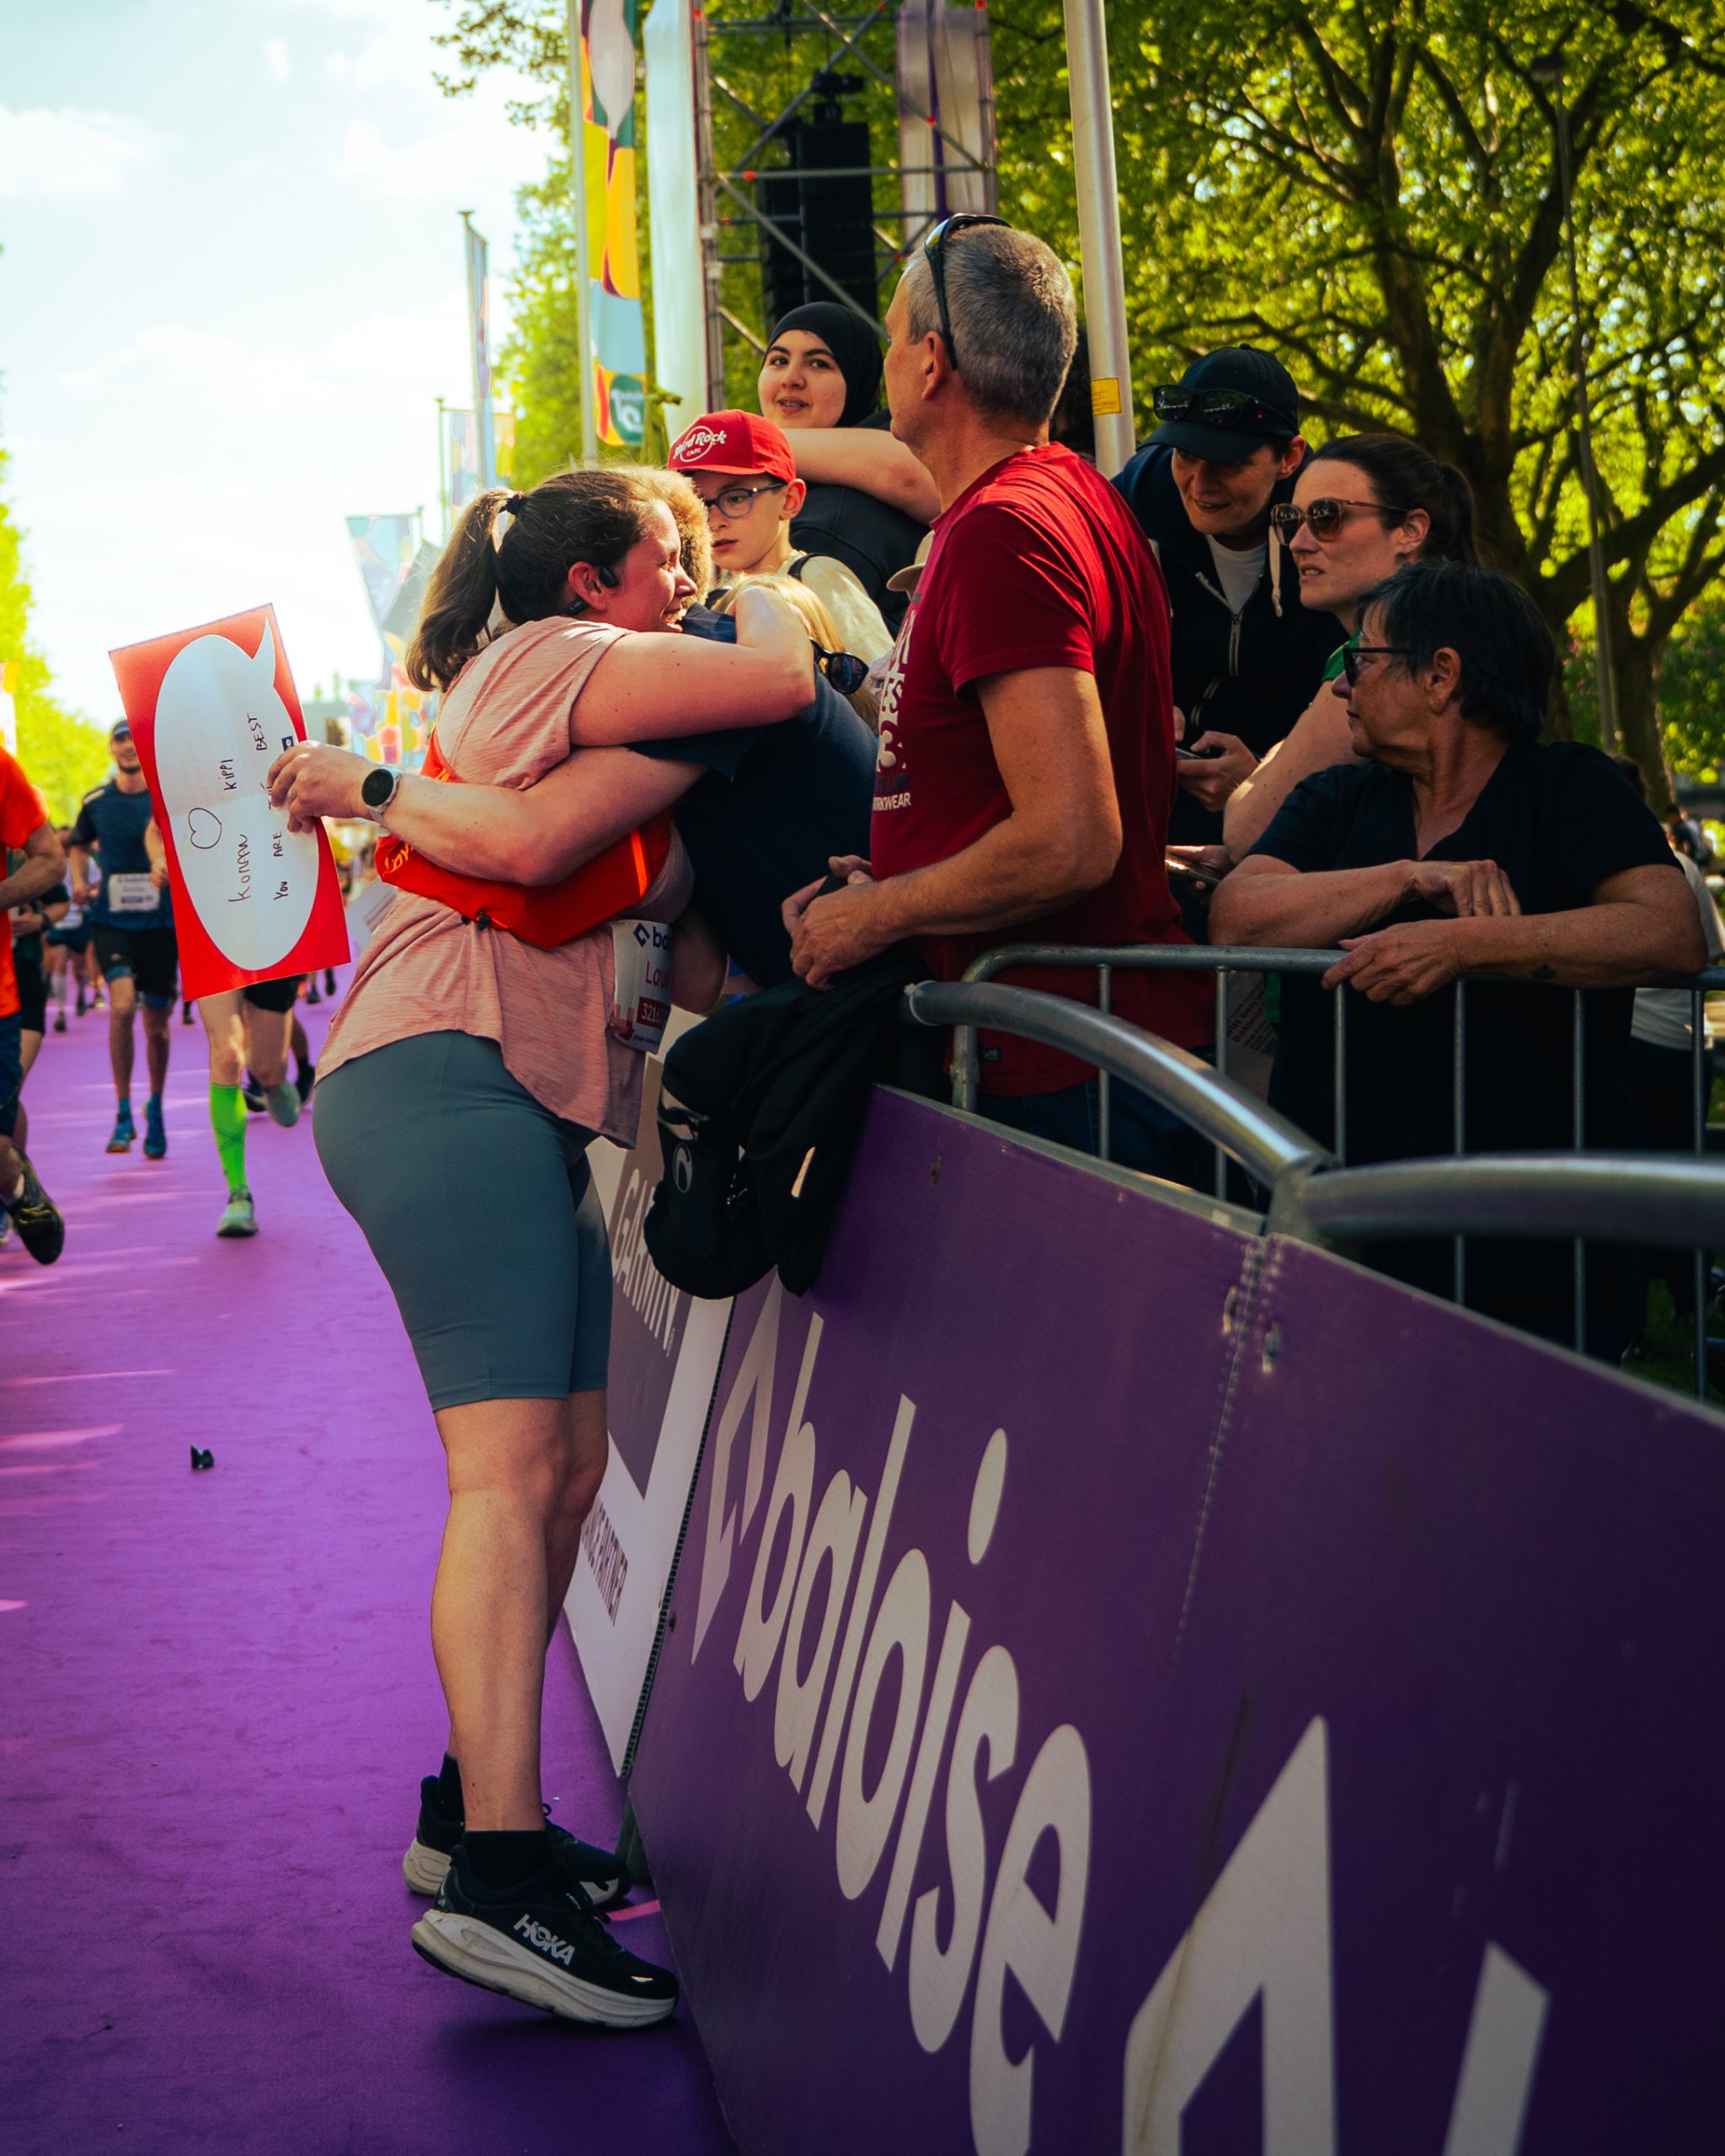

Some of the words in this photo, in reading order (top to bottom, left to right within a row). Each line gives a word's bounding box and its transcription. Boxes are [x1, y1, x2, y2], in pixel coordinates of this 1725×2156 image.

[695, 430, 727, 446] Rock
[246, 712, 268, 751] BEST
[273, 830, 284, 857] ARE
[594, 1516, 628, 1627] PARTNER
[733, 1311, 1092, 2156] baloise
[513, 1913, 575, 1966] HOKA
